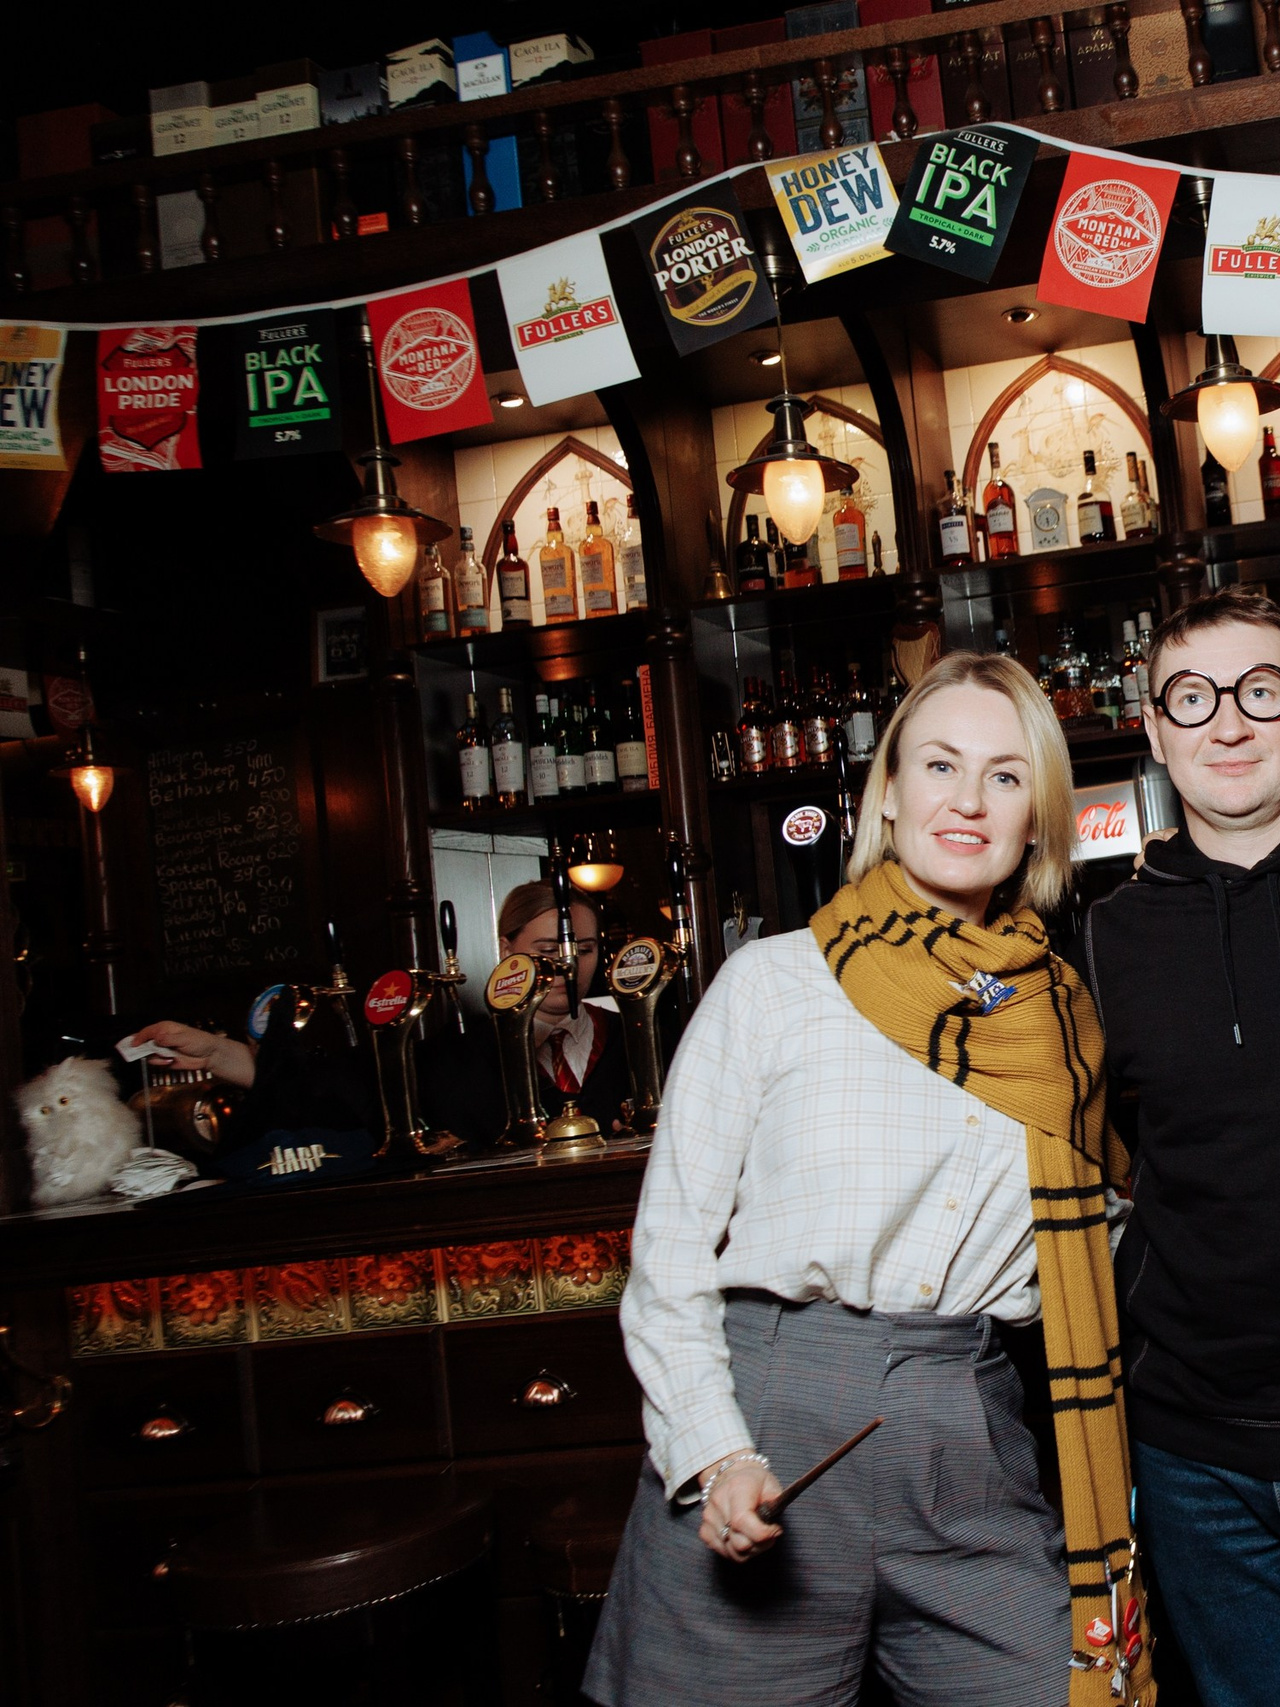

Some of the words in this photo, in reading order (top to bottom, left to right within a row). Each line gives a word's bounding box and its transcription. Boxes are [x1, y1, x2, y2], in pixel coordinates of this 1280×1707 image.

[279, 113, 291, 124] 12
[173, 133, 185, 144] 12
[233, 128, 245, 139] 12
[780, 146, 870, 197] HONEY
[929, 142, 1013, 187] BLACK
[789, 167, 884, 236] DEW
[915, 163, 997, 230] IPA
[668, 219, 714, 246] FULLER'S
[819, 214, 879, 243] ORGANIC
[919, 212, 956, 231] TROPICAL
[963, 228, 985, 241] DARK
[1077, 217, 1141, 241] MONTANA
[1081, 232, 1094, 240] RYE
[1093, 233, 1120, 249] RED
[1119, 240, 1132, 248] ALE
[662, 228, 730, 267] LONDON
[928, 235, 957, 254] 5.7%
[654, 237, 755, 292] PORTER
[522, 304, 609, 342] FULLER'S
[245, 343, 323, 371] BLACK
[399, 342, 459, 366] MONTANA
[416, 358, 442, 374] RED
[0, 361, 56, 388] ONEY
[104, 373, 194, 392] LONDON
[118, 392, 182, 410] PRIDE
[246, 366, 330, 412] IPA
[0, 387, 52, 429] EW
[641, 668, 655, 729] БАРМЕНА
[192, 761, 236, 780] Sheep
[647, 735, 660, 788] БИБЛИЯ
[149, 778, 240, 808] Belhaven
[247, 766, 286, 788] 450
[1075, 800, 1128, 843] Cola
[158, 876, 218, 897] Spaten
[368, 995, 408, 1008] Estrella
[271, 1143, 326, 1176] HARP
